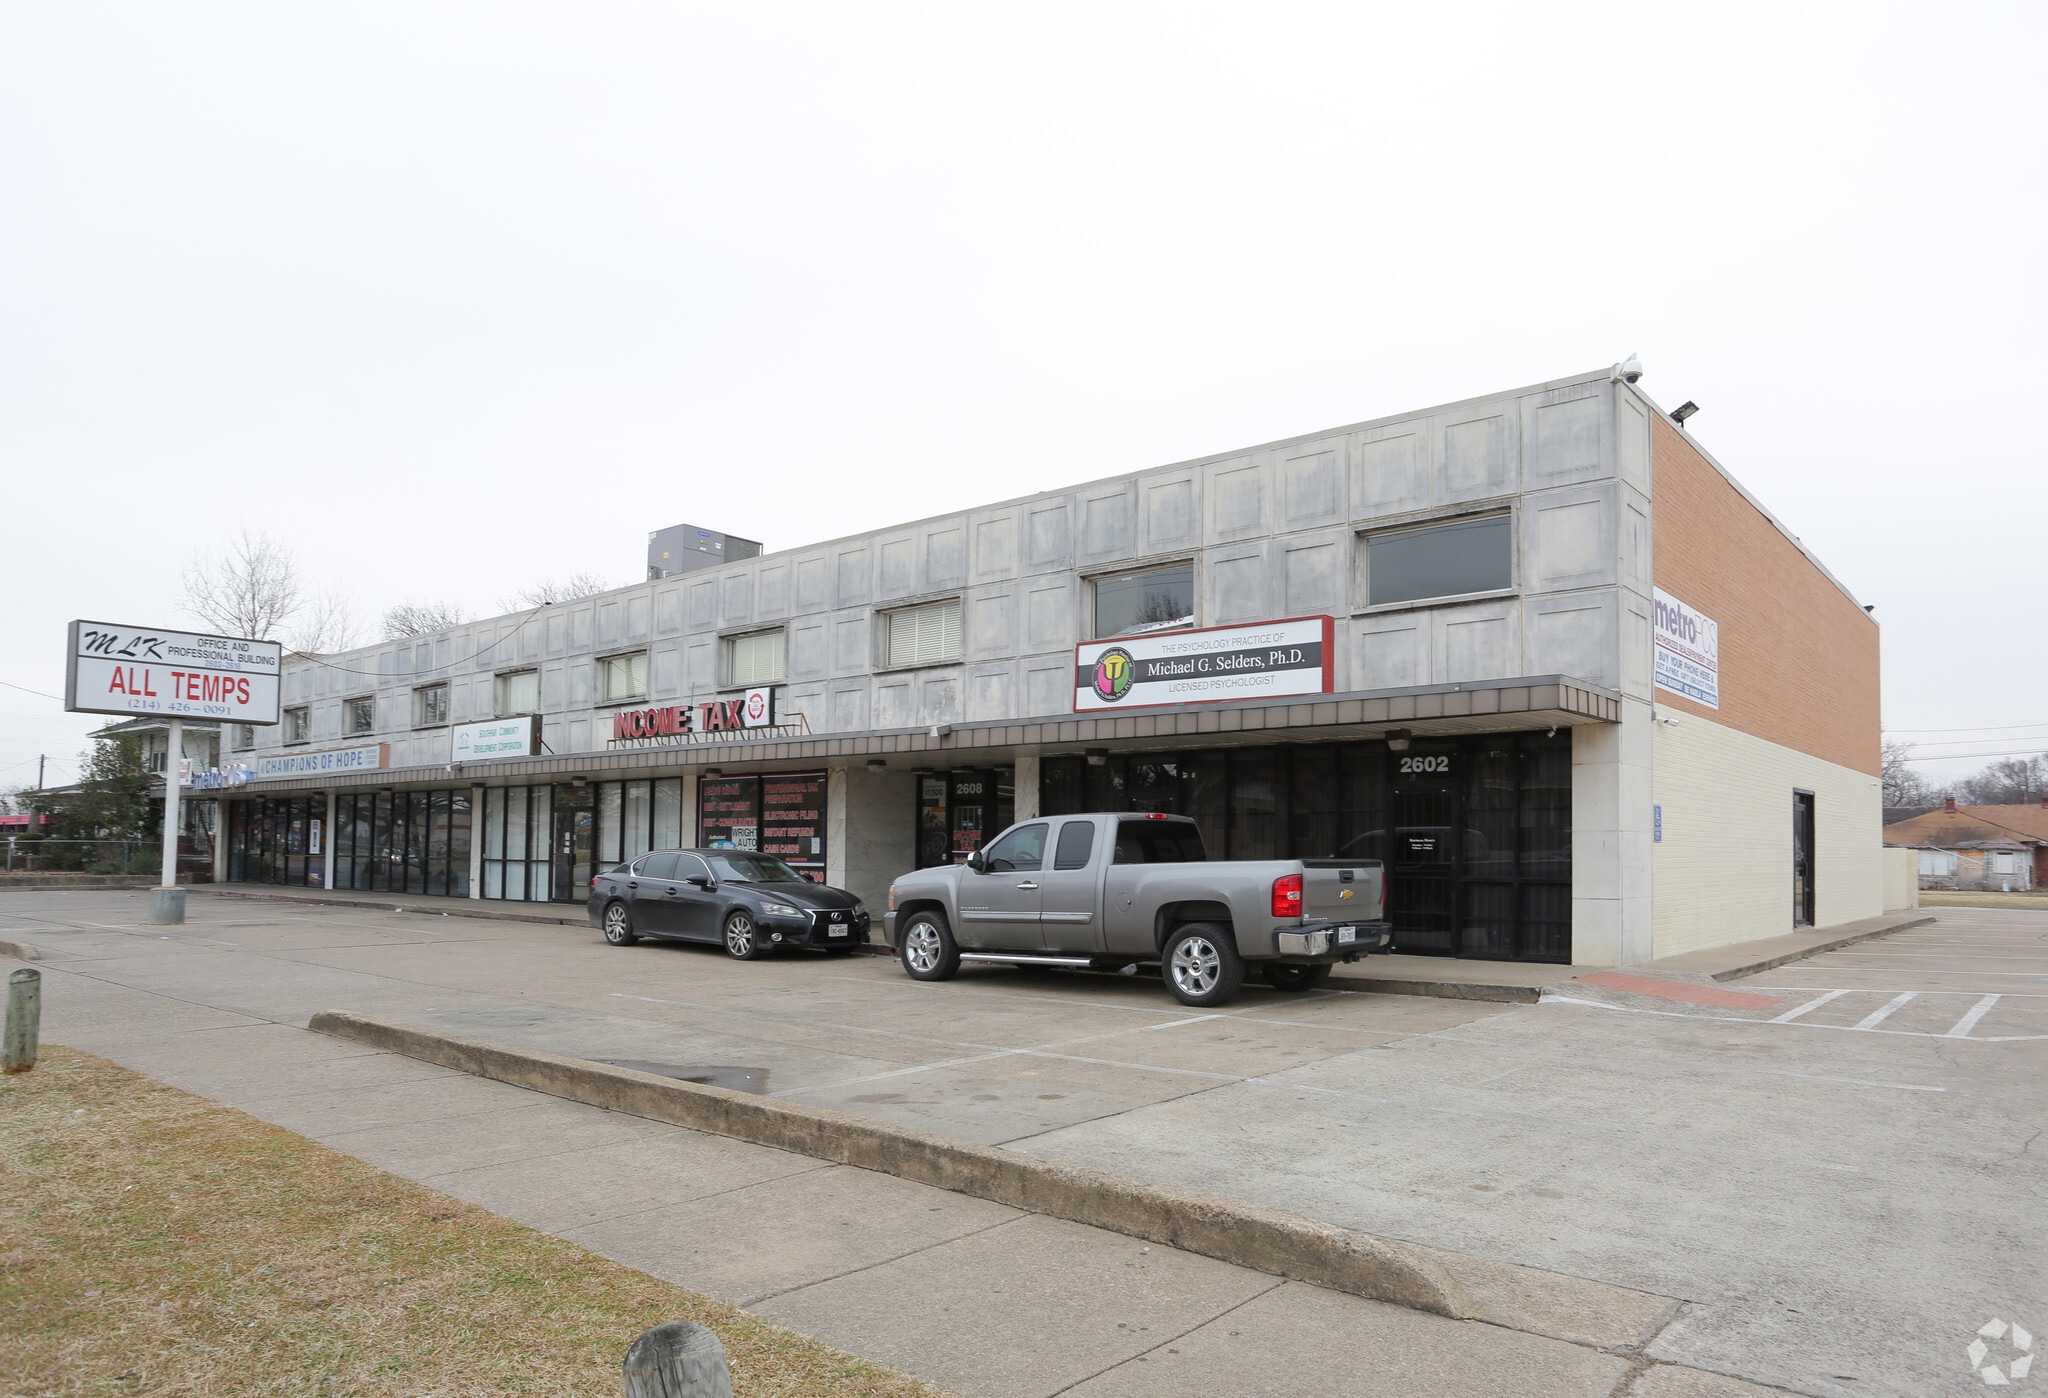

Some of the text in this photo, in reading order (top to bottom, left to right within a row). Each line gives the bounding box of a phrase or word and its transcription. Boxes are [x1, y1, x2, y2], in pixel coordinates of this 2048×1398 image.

[1654, 599, 1716, 658] metroPCS
[84, 631, 167, 659] MLK
[197, 638, 250, 652] OFFICE AND
[1162, 633, 1285, 654] THE PSYCHOLOGY PRACTICE OF
[168, 646, 276, 666] PROFESSIONAL BUILDING
[1147, 649, 1306, 677] Michael G. Selders, Ph.D.
[1659, 651, 1669, 663] BUY
[1671, 656, 1683, 669] YOUR
[1684, 662, 1699, 676] PHONE
[1700, 669, 1710, 681] HERE
[109, 666, 250, 705] ALL TEMPS
[1169, 675, 1276, 693] LICENSED PSYCHOLOGIST
[128, 698, 161, 711] (214)
[614, 705, 690, 738] INCOME
[699, 700, 743, 730] TAX
[265, 754, 318, 774] CHAMPIONS
[320, 754, 333, 769] OF
[336, 750, 363, 767] HOPE
[1400, 756, 1449, 773] 2602
[956, 783, 982, 794] 2608
[738, 839, 757, 847] AUTO
[953, 830, 981, 840] INCOME
[764, 844, 779, 853] CASH
[780, 844, 799, 853] CARDS
[960, 841, 974, 851] TAX
